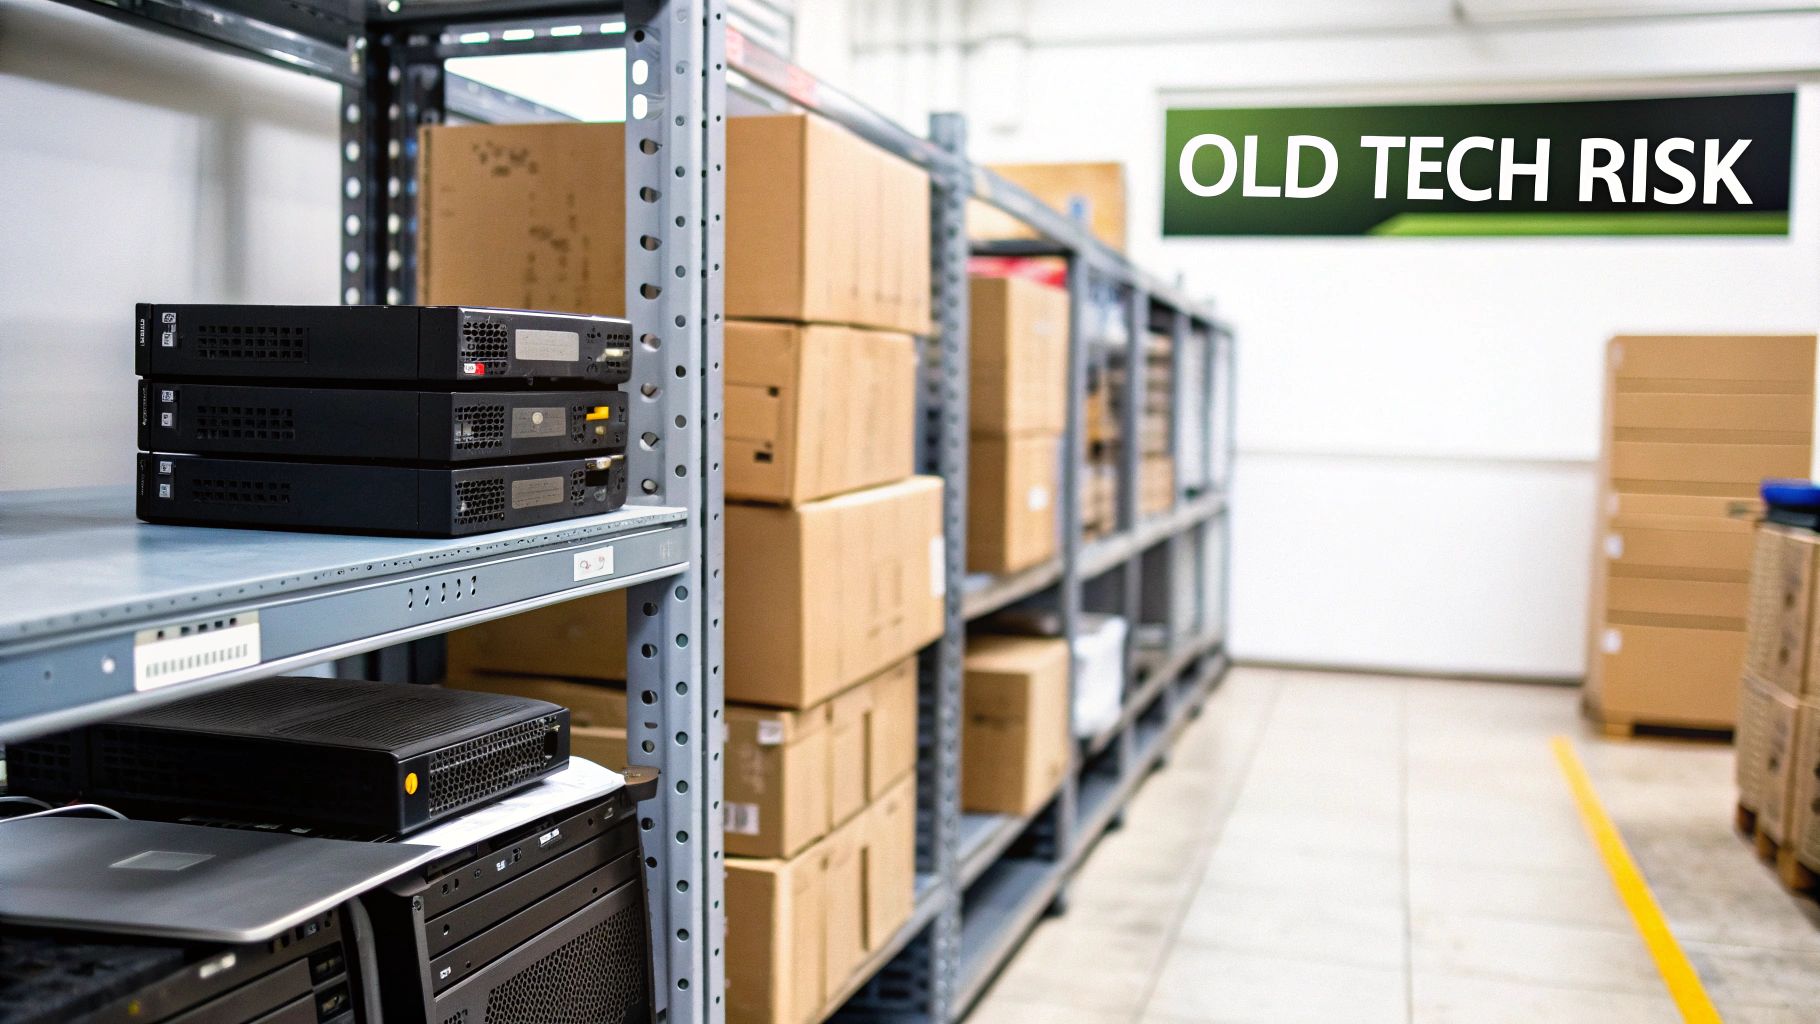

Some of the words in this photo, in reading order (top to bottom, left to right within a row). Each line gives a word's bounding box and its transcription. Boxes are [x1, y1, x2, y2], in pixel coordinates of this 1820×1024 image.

[1179, 133, 1339, 199] OLD
[1360, 135, 1551, 202] TECH
[1578, 137, 1753, 205] RISK
